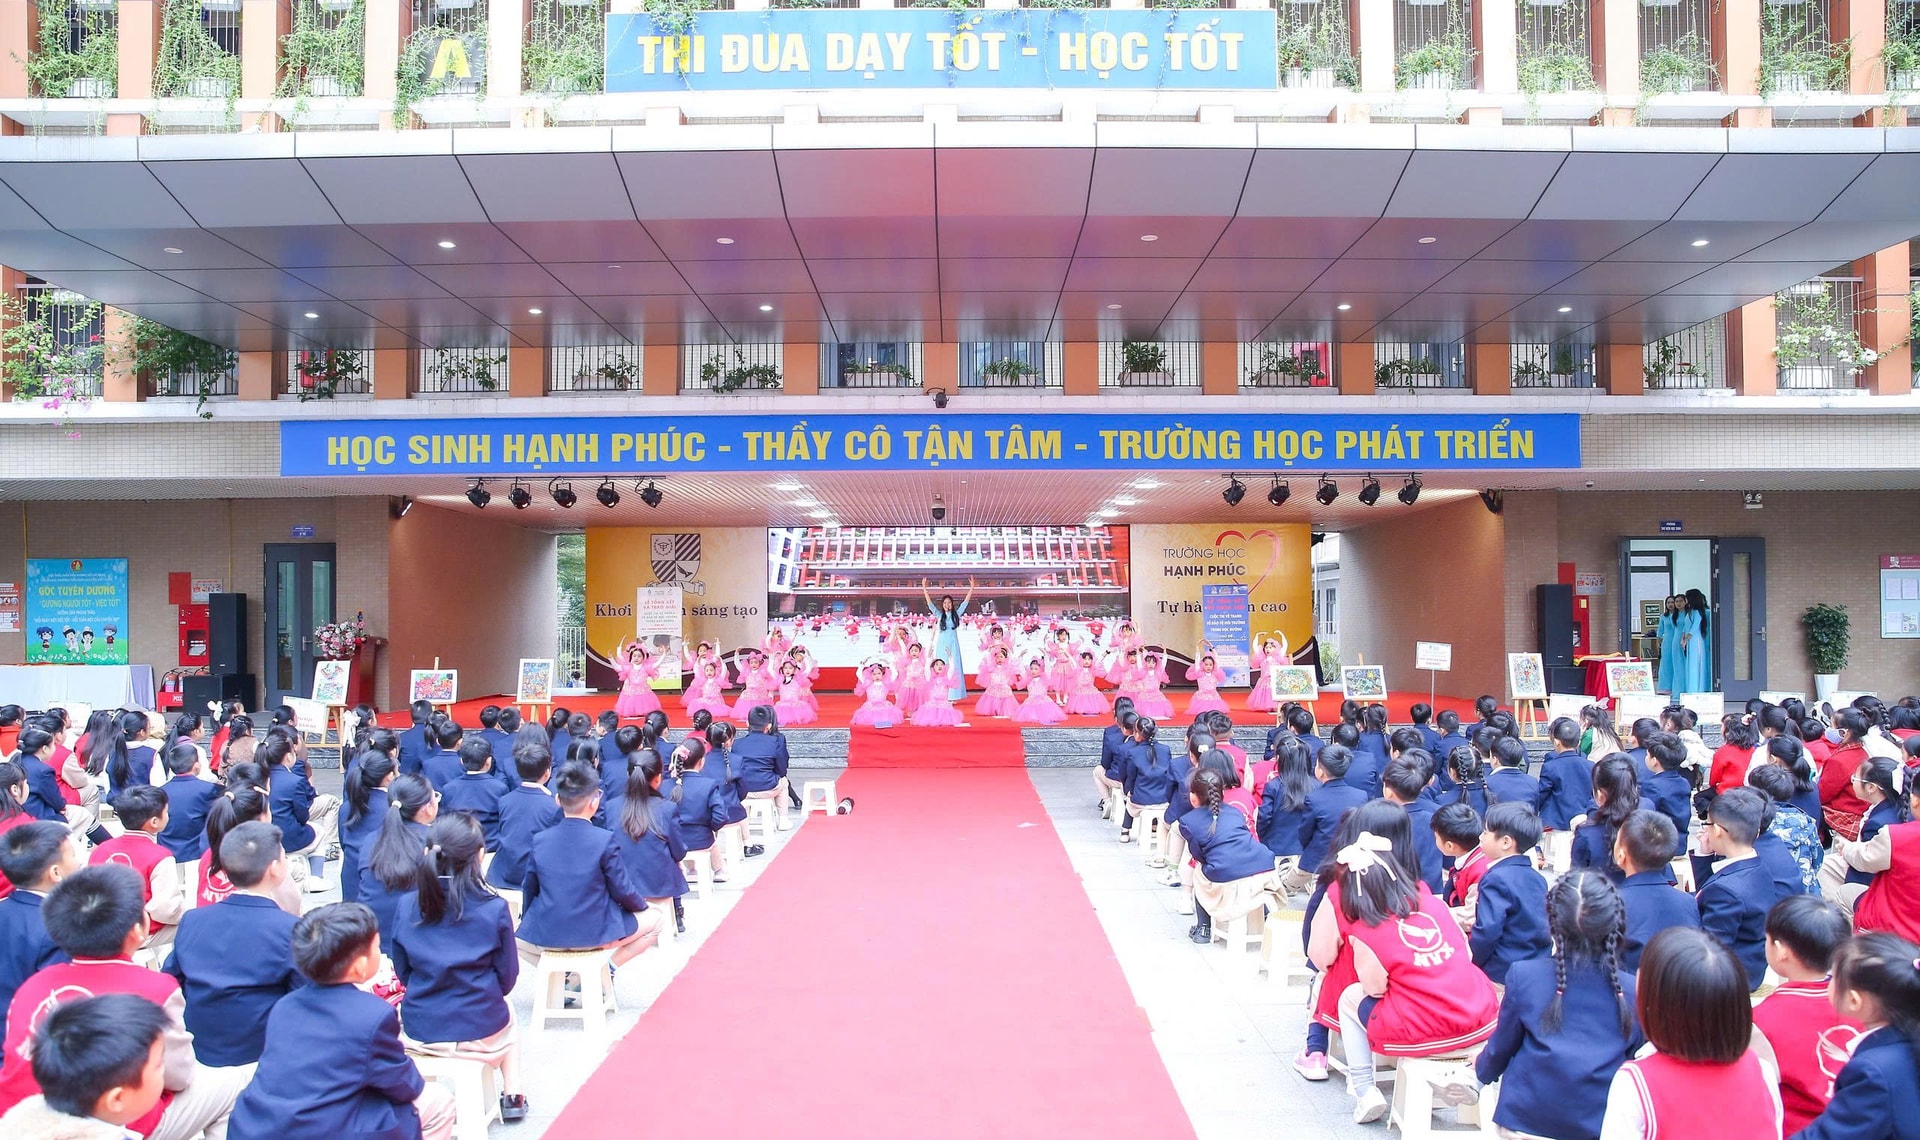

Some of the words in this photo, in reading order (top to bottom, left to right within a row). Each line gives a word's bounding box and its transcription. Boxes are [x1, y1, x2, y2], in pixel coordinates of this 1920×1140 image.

[637, 35, 705, 74] THI
[720, 33, 809, 72] ĐUA
[825, 33, 912, 79] DẠY
[926, 16, 1006, 71] TỐT
[1022, 47, 1038, 56] -
[1059, 32, 1148, 79] HỌC
[1164, 17, 1244, 71] TỐT
[430, 38, 472, 78] A
[327, 435, 396, 472] HỌC
[407, 434, 491, 465] SINH
[503, 433, 599, 470] HẠNH
[611, 426, 706, 463] PHÚC
[743, 421, 832, 461] THẦY
[844, 424, 892, 461] CÔ
[903, 424, 972, 466] TẬN
[985, 424, 1062, 460] TÂM
[1099, 422, 1240, 460] TRƯỜNG
[1253, 429, 1323, 466] HỌC
[1336, 423, 1424, 460] PHÁT
[1434, 418, 1534, 459] TRIỂN
[1163, 546, 1214, 559] TRƯỜNG
[1217, 548, 1246, 560] HỌC
[1164, 566, 1203, 579] HẠNH
[1208, 563, 1246, 576] PHÚC
[595, 604, 632, 617] Khơi
[691, 604, 728, 618] sáng
[733, 605, 758, 619] tạo
[1157, 601, 1179, 616] Tự
[1184, 601, 1202, 612] hà
[1260, 603, 1287, 612] cao
